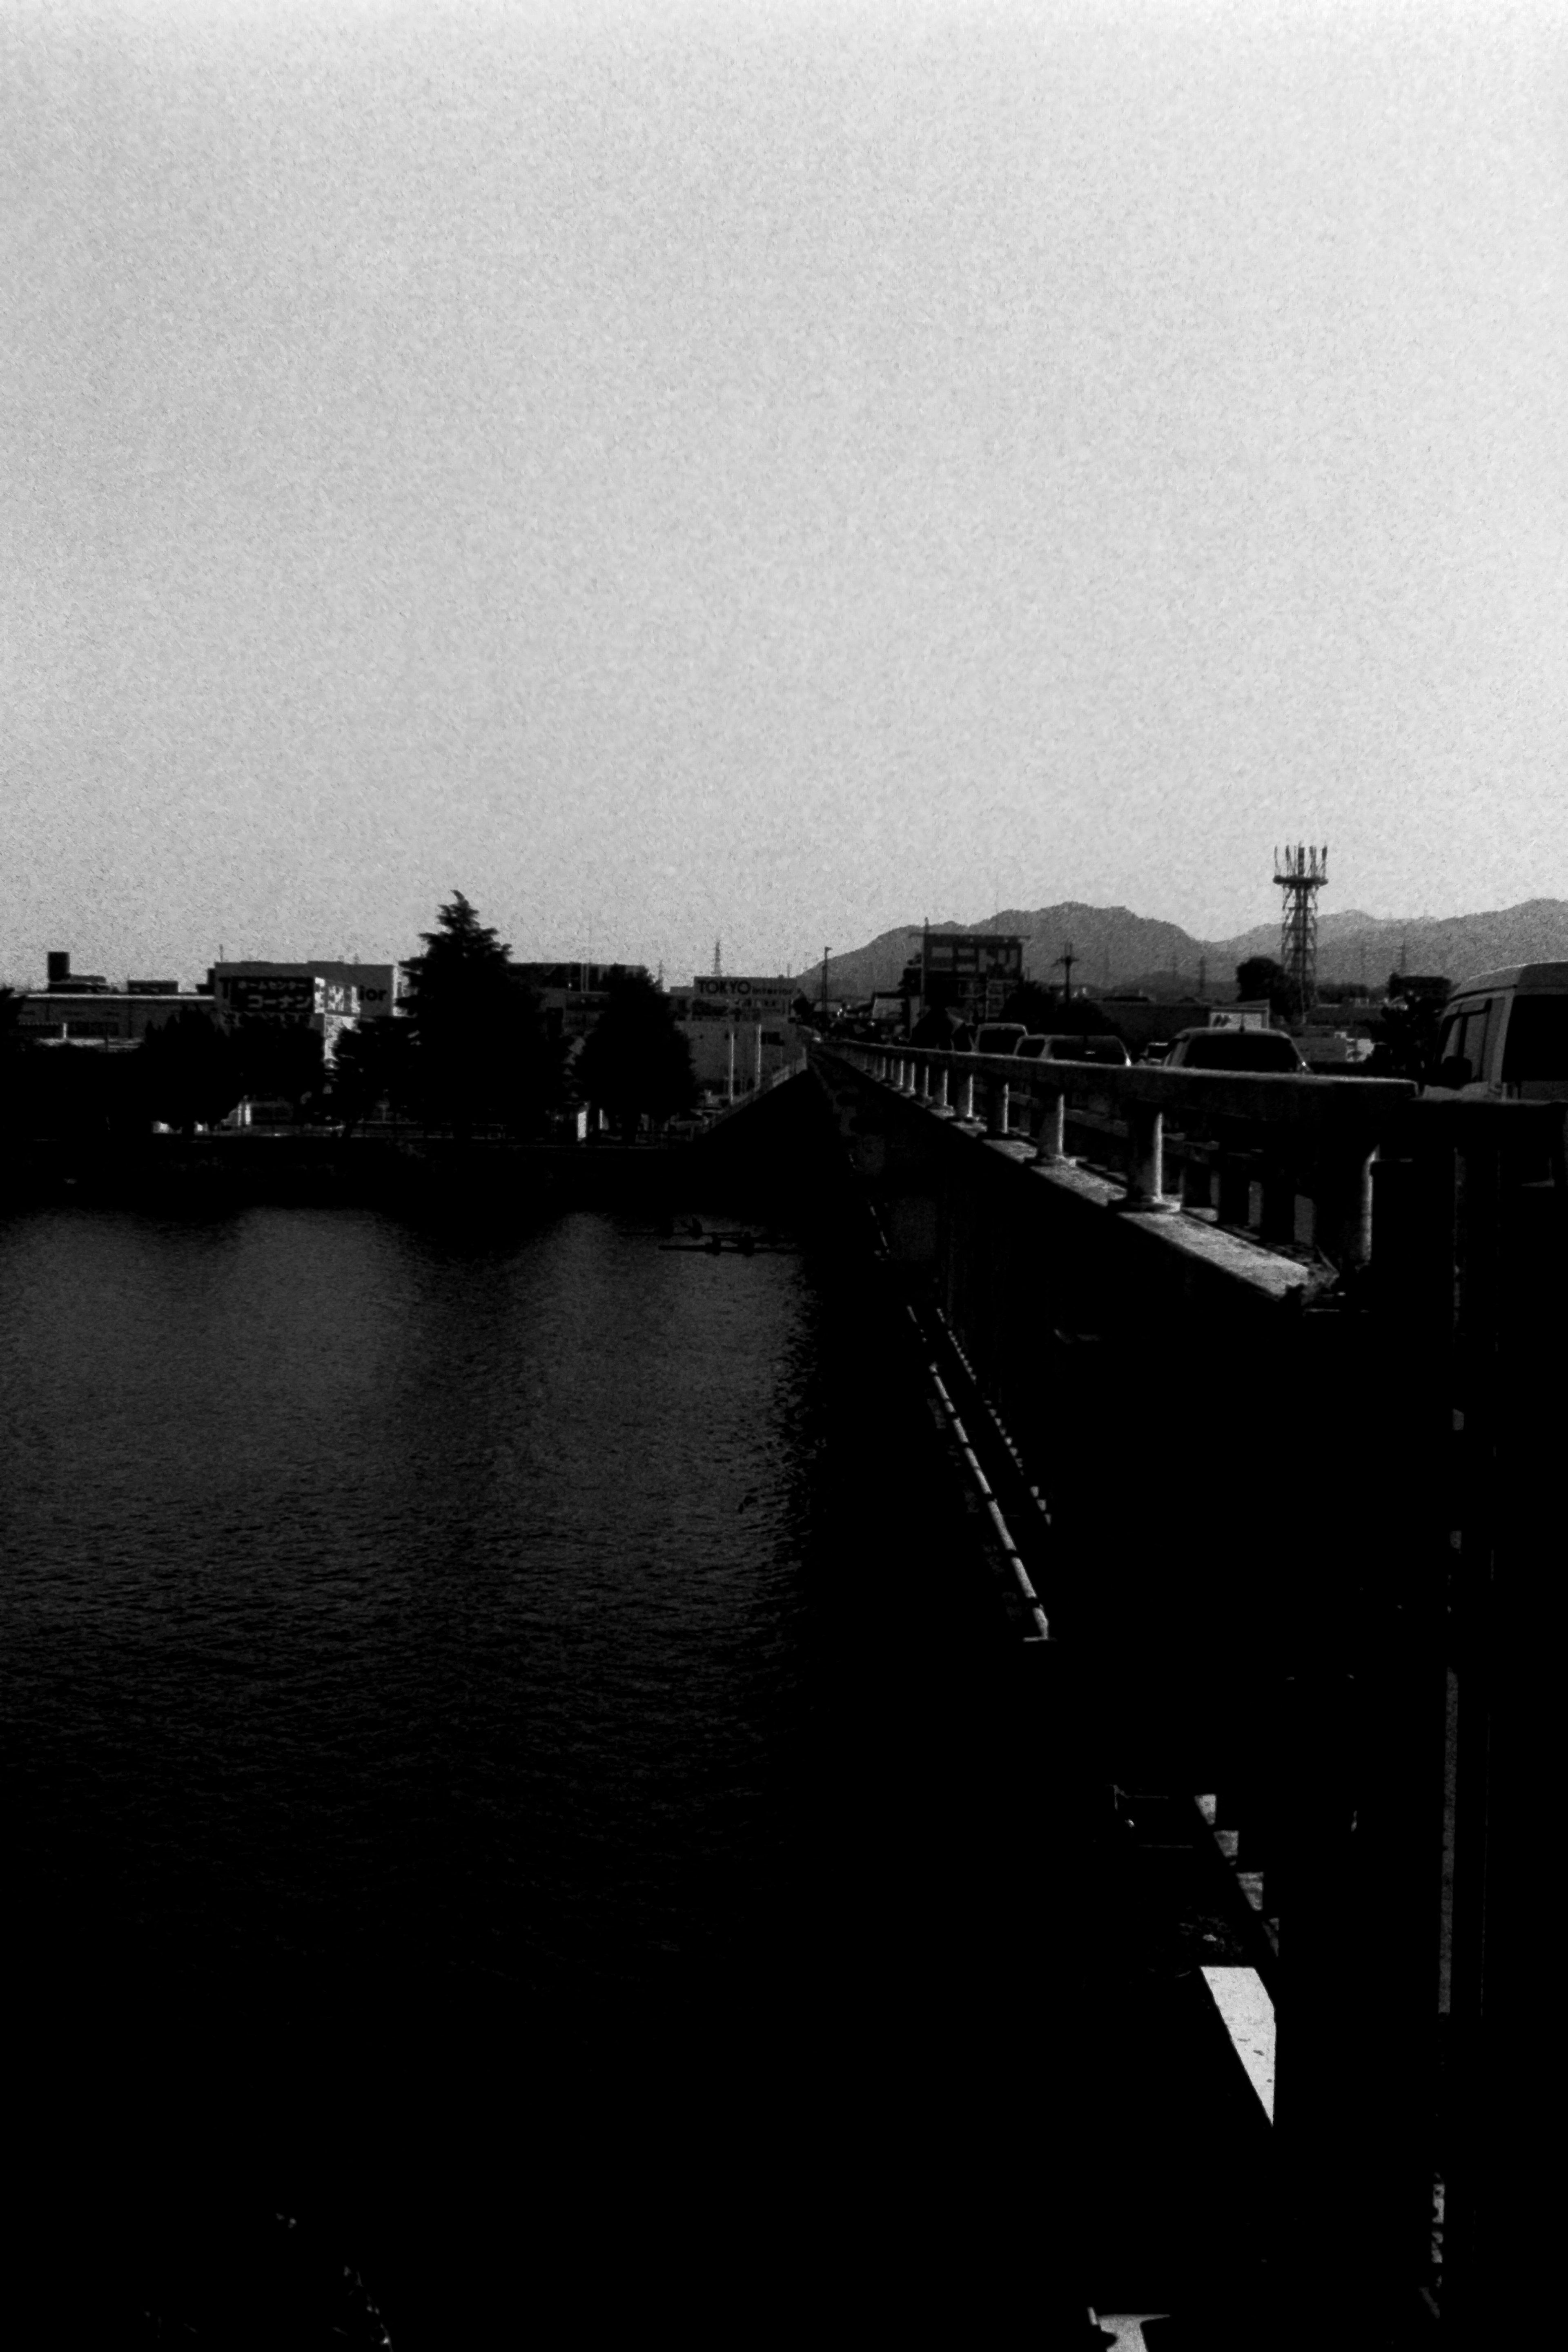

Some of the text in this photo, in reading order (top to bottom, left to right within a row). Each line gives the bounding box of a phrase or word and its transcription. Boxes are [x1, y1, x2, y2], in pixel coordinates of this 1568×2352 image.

[697, 980, 751, 995] TOKYO
[247, 994, 312, 1009] コーナン
